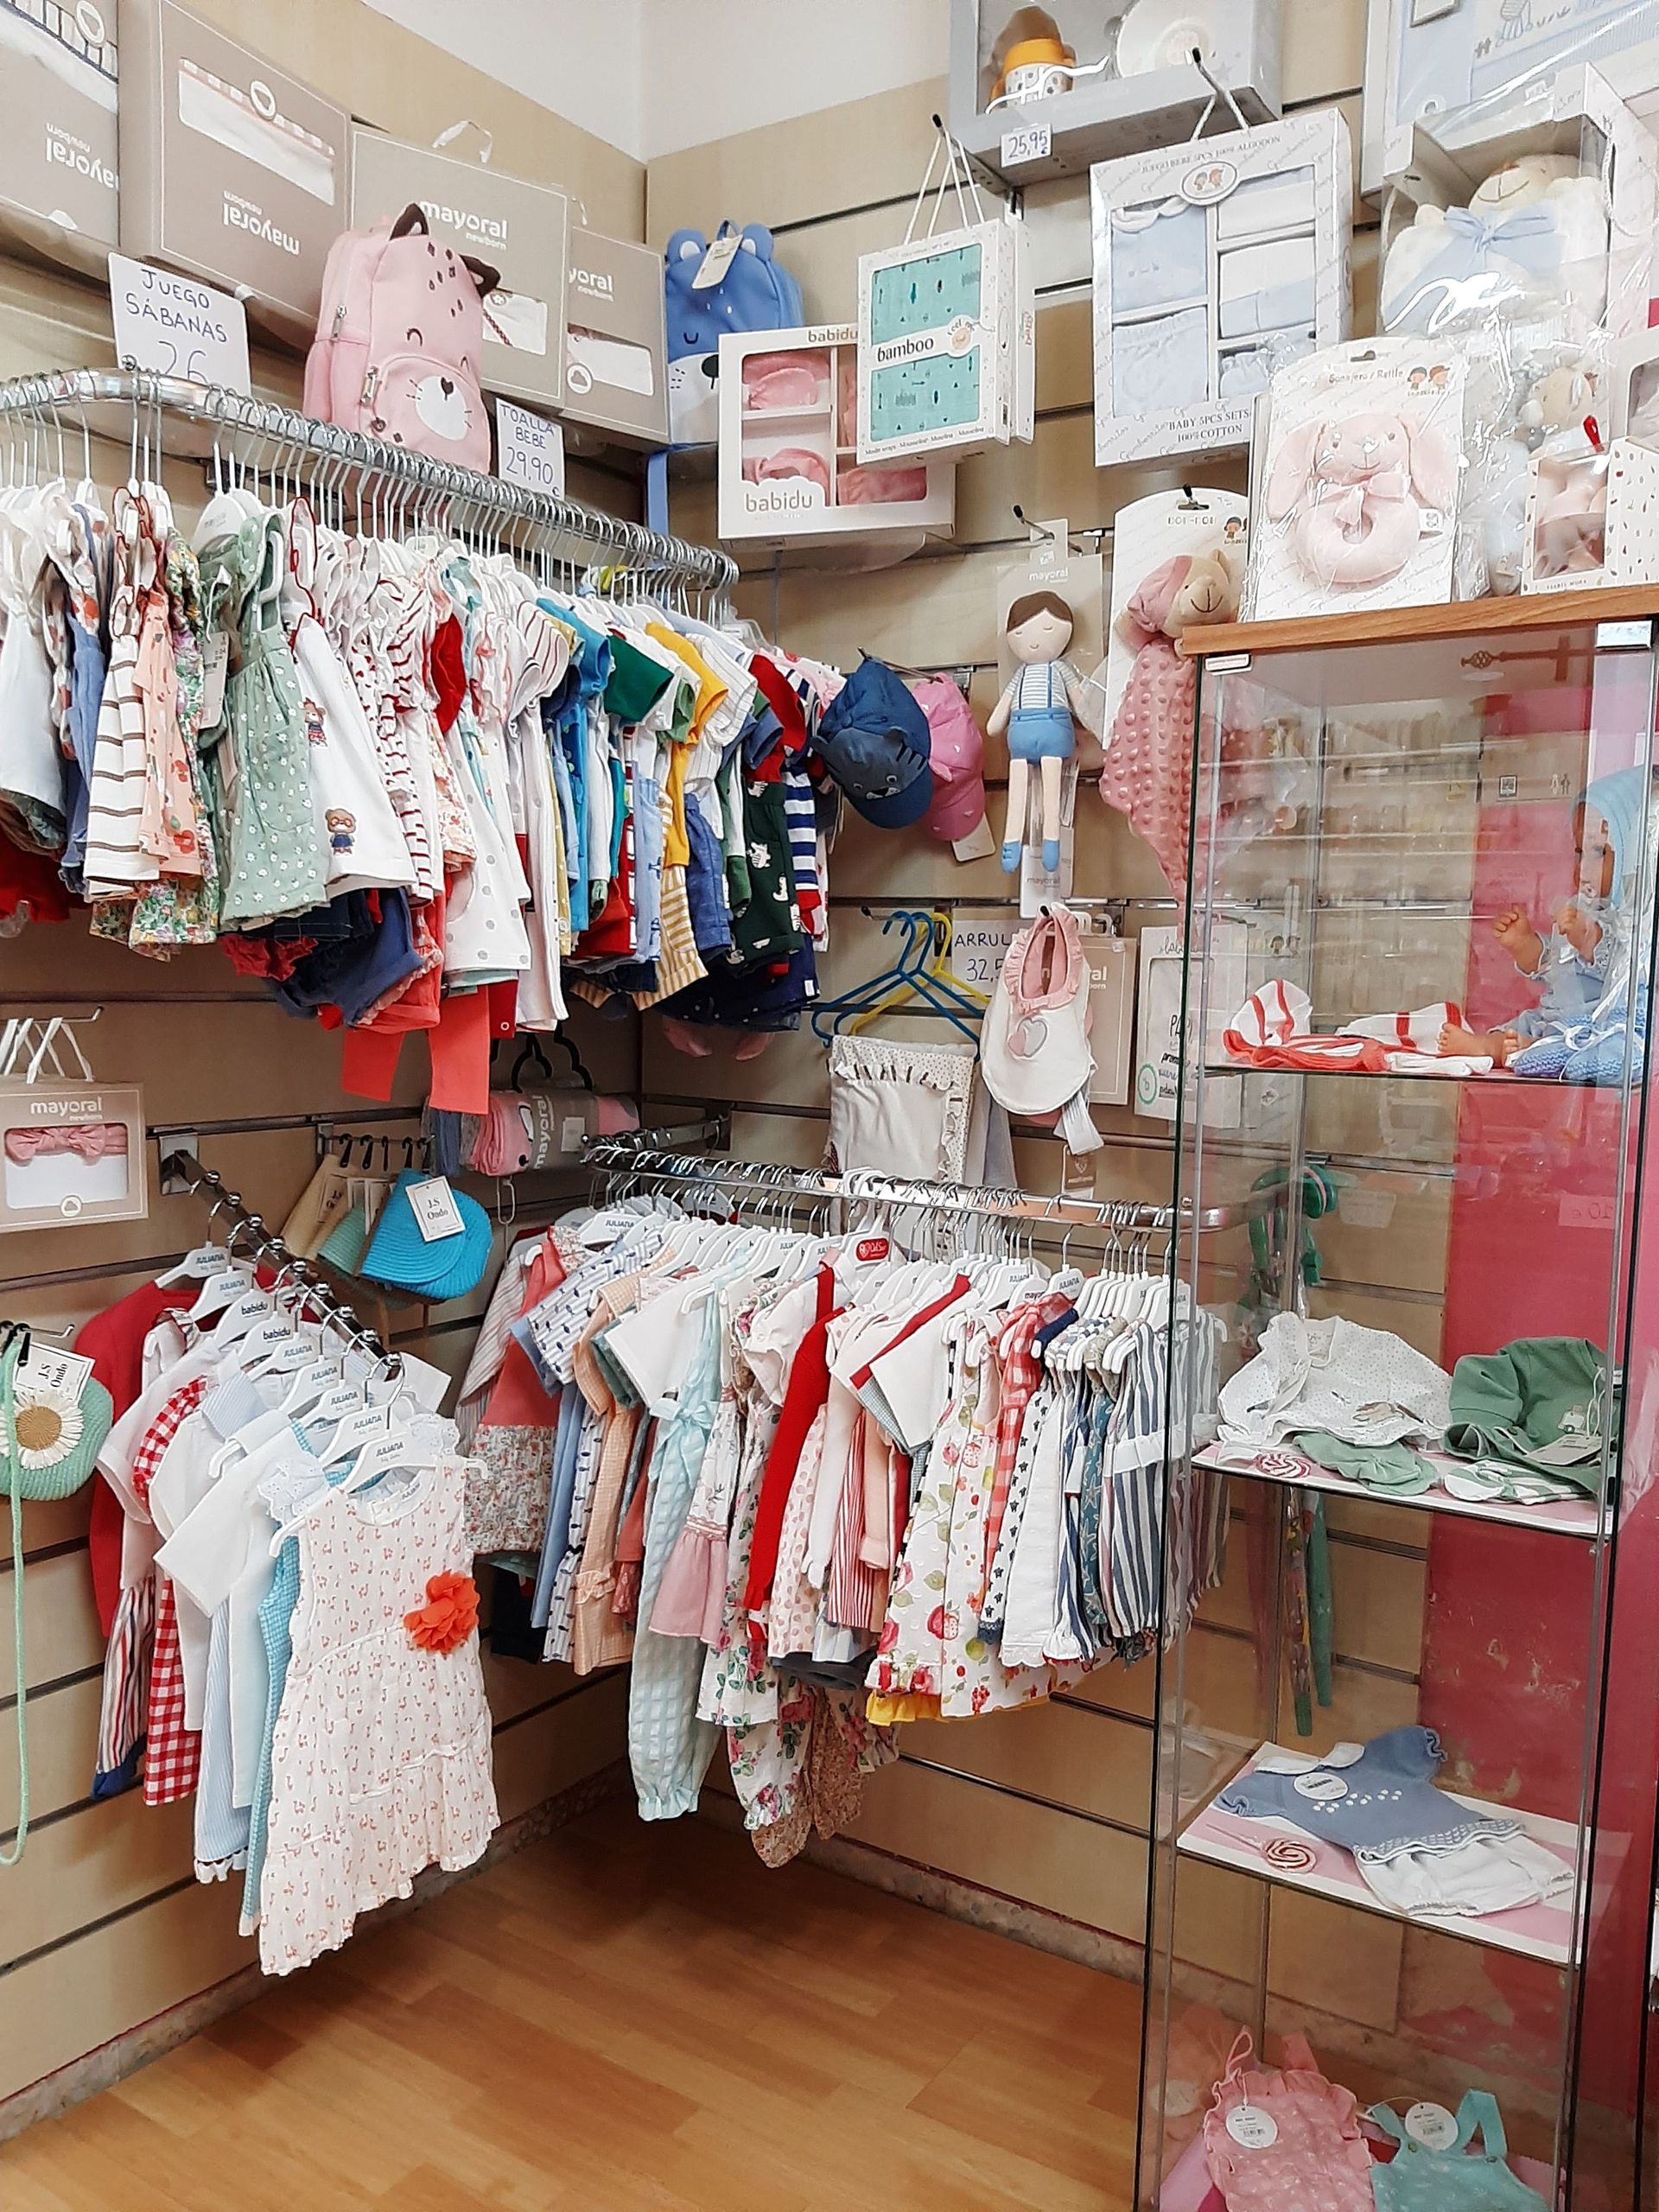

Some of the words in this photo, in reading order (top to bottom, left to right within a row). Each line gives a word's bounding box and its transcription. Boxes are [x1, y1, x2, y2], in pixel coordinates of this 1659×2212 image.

[1008, 130, 1048, 158] 25,95
[223, 203, 301, 256] mayoral
[419, 200, 508, 239] mayoral
[465, 232, 507, 251] newborn
[141, 268, 210, 309] JUEGO
[569, 267, 613, 292] yoral
[125, 292, 227, 343] SÁBANAS
[808, 326, 858, 343] babidu
[877, 337, 934, 362] bamboo
[158, 340, 209, 384] 26
[499, 404, 555, 437] TOALLA
[1168, 417, 1197, 430] BABY
[1198, 413, 1223, 425] 5PCS
[1225, 409, 1249, 421] SETS
[1200, 423, 1243, 439] COTTON
[505, 446, 554, 485] 29.90
[745, 489, 813, 512] babidu
[1028, 567, 1069, 582] mayoral
[954, 932, 1011, 948] ARRUL
[966, 957, 1003, 983] 32,5
[30, 1096, 103, 1117] mayoral
[531, 1095, 551, 1169] mayoral
[427, 1209, 448, 1221] Ondo
[779, 1241, 797, 1250] JULIA
[241, 1301, 269, 1314] babidu
[263, 1327, 291, 1340] babidu
[50, 1363, 68, 1388] Ondo
[330, 1391, 359, 1406] JULIANA
[353, 1414, 382, 1430] JULIANA
[376, 1441, 404, 1458] JULIANA
